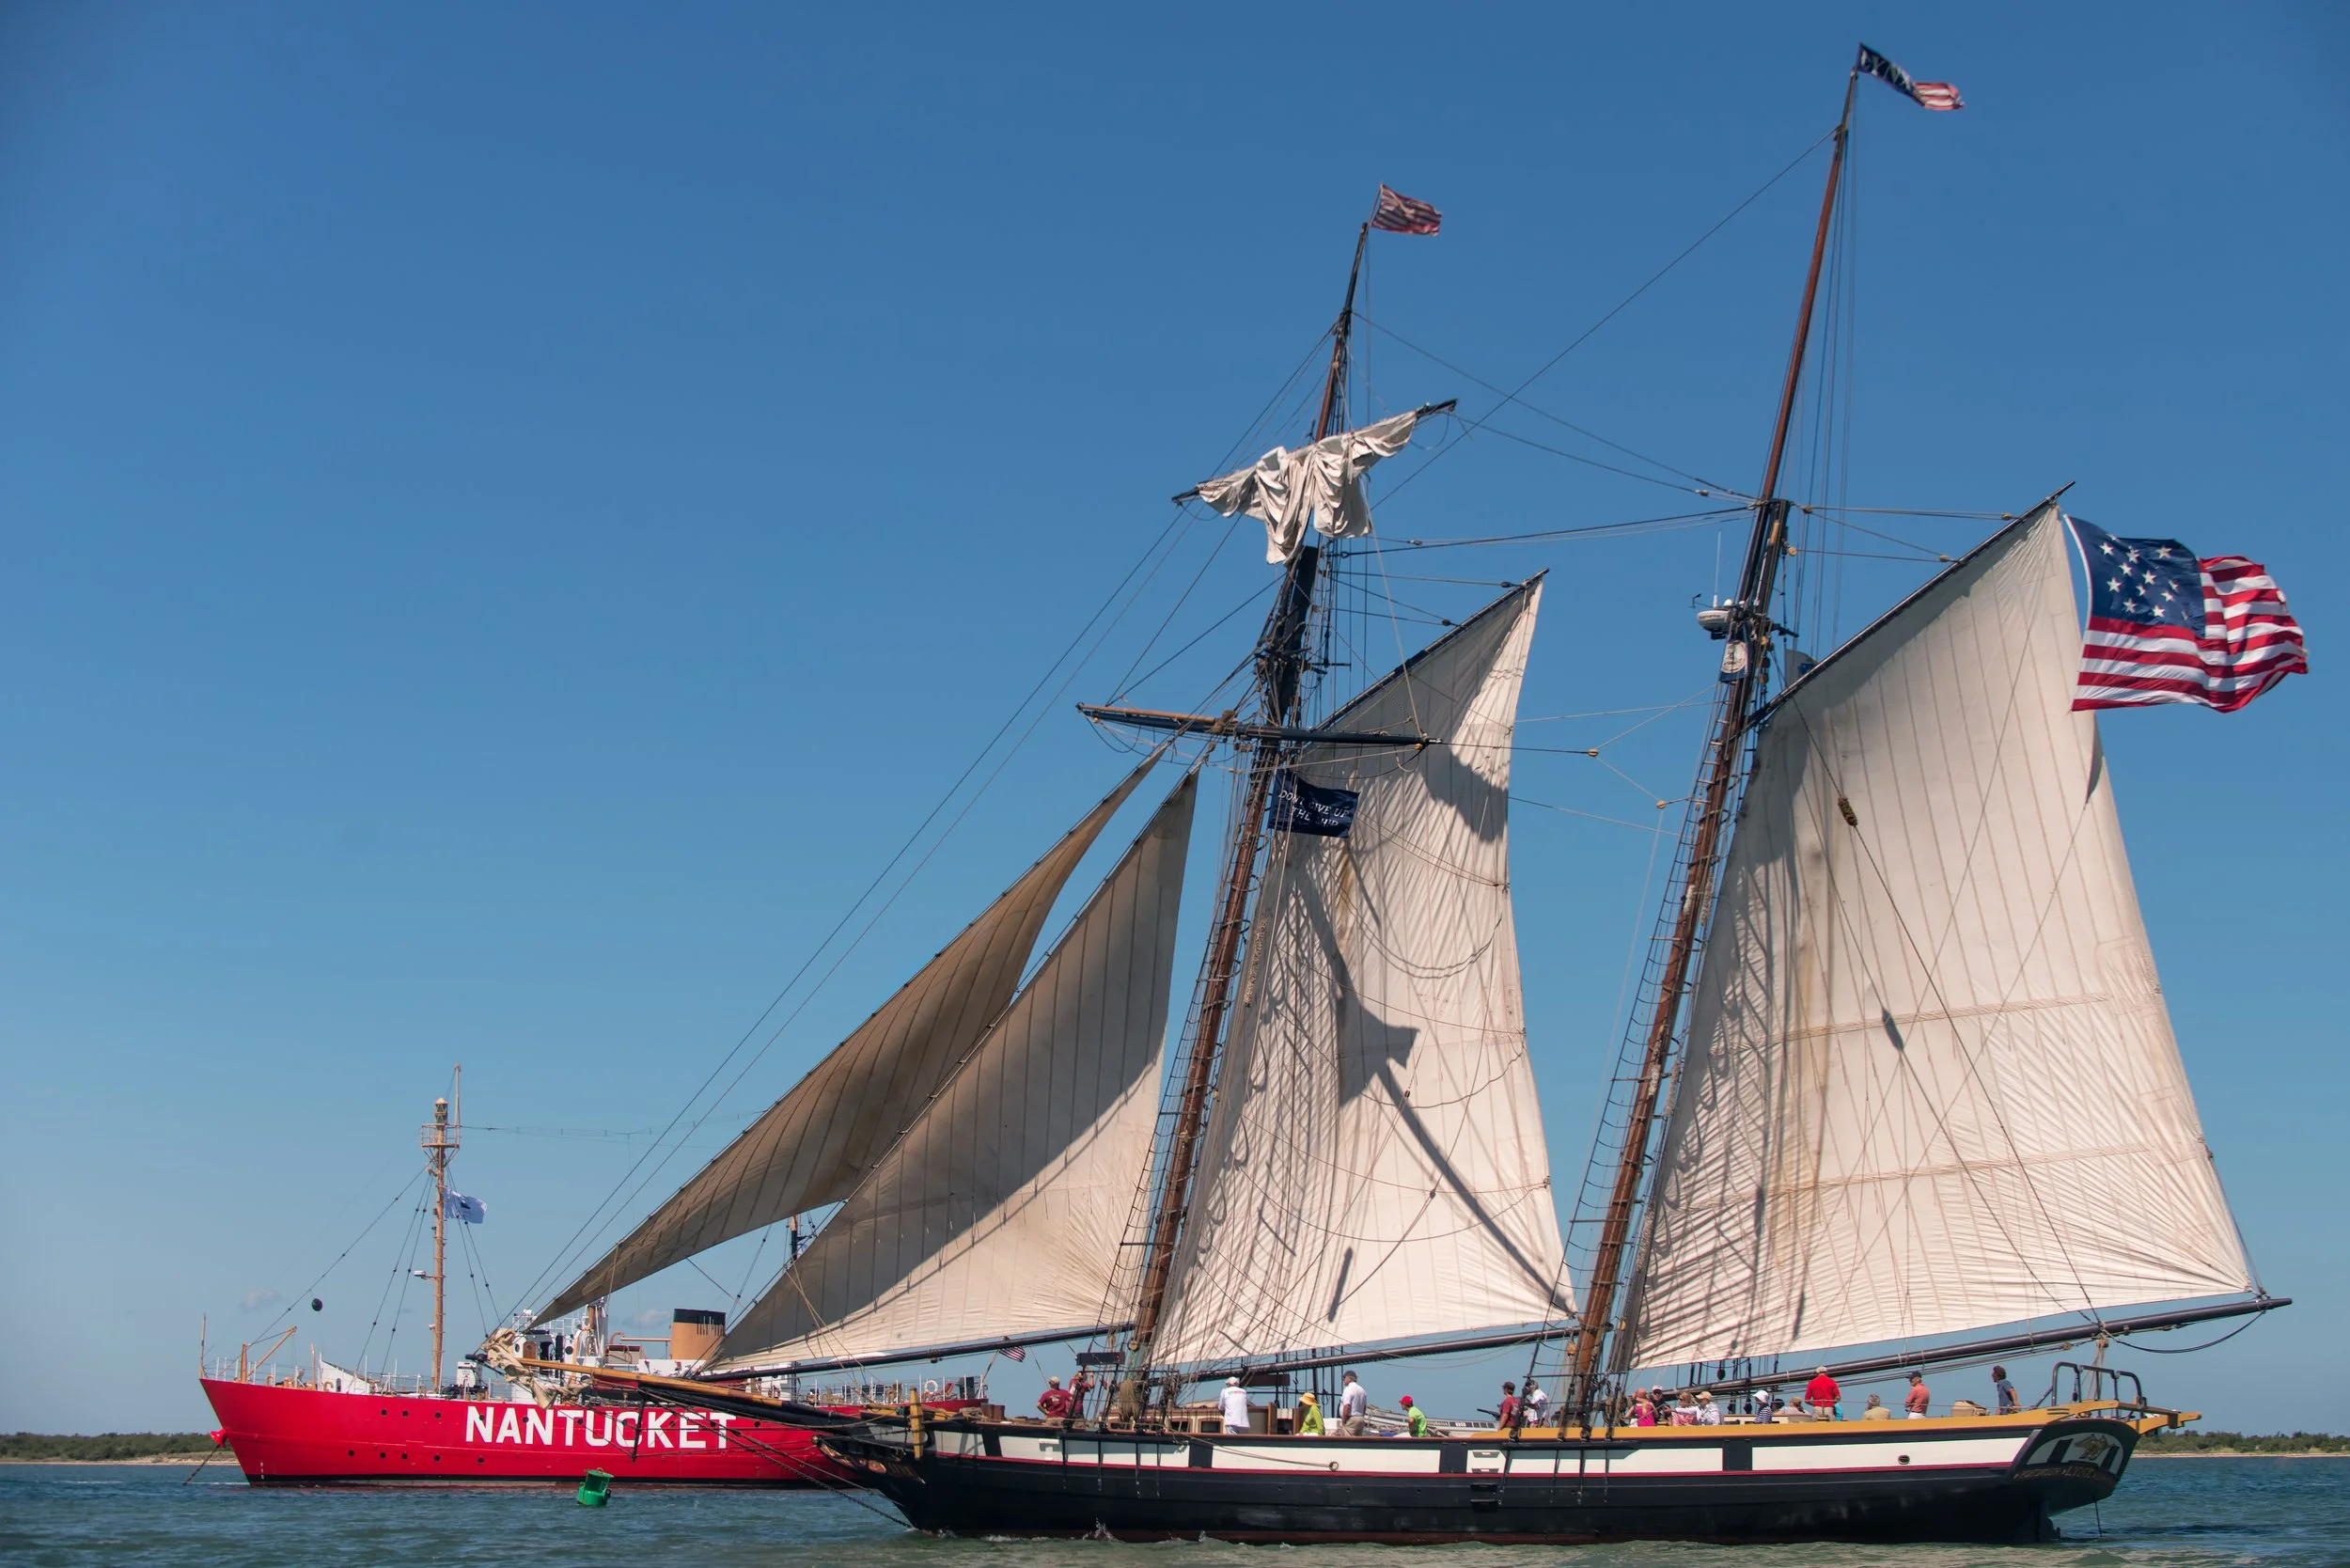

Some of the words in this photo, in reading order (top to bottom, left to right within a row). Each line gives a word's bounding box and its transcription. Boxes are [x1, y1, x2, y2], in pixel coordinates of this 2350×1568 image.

[1292, 806, 1311, 822] THE
[1308, 802, 1331, 815] GIVE
[1333, 808, 1350, 818] UP
[465, 1405, 736, 1449] NANTUCKET
